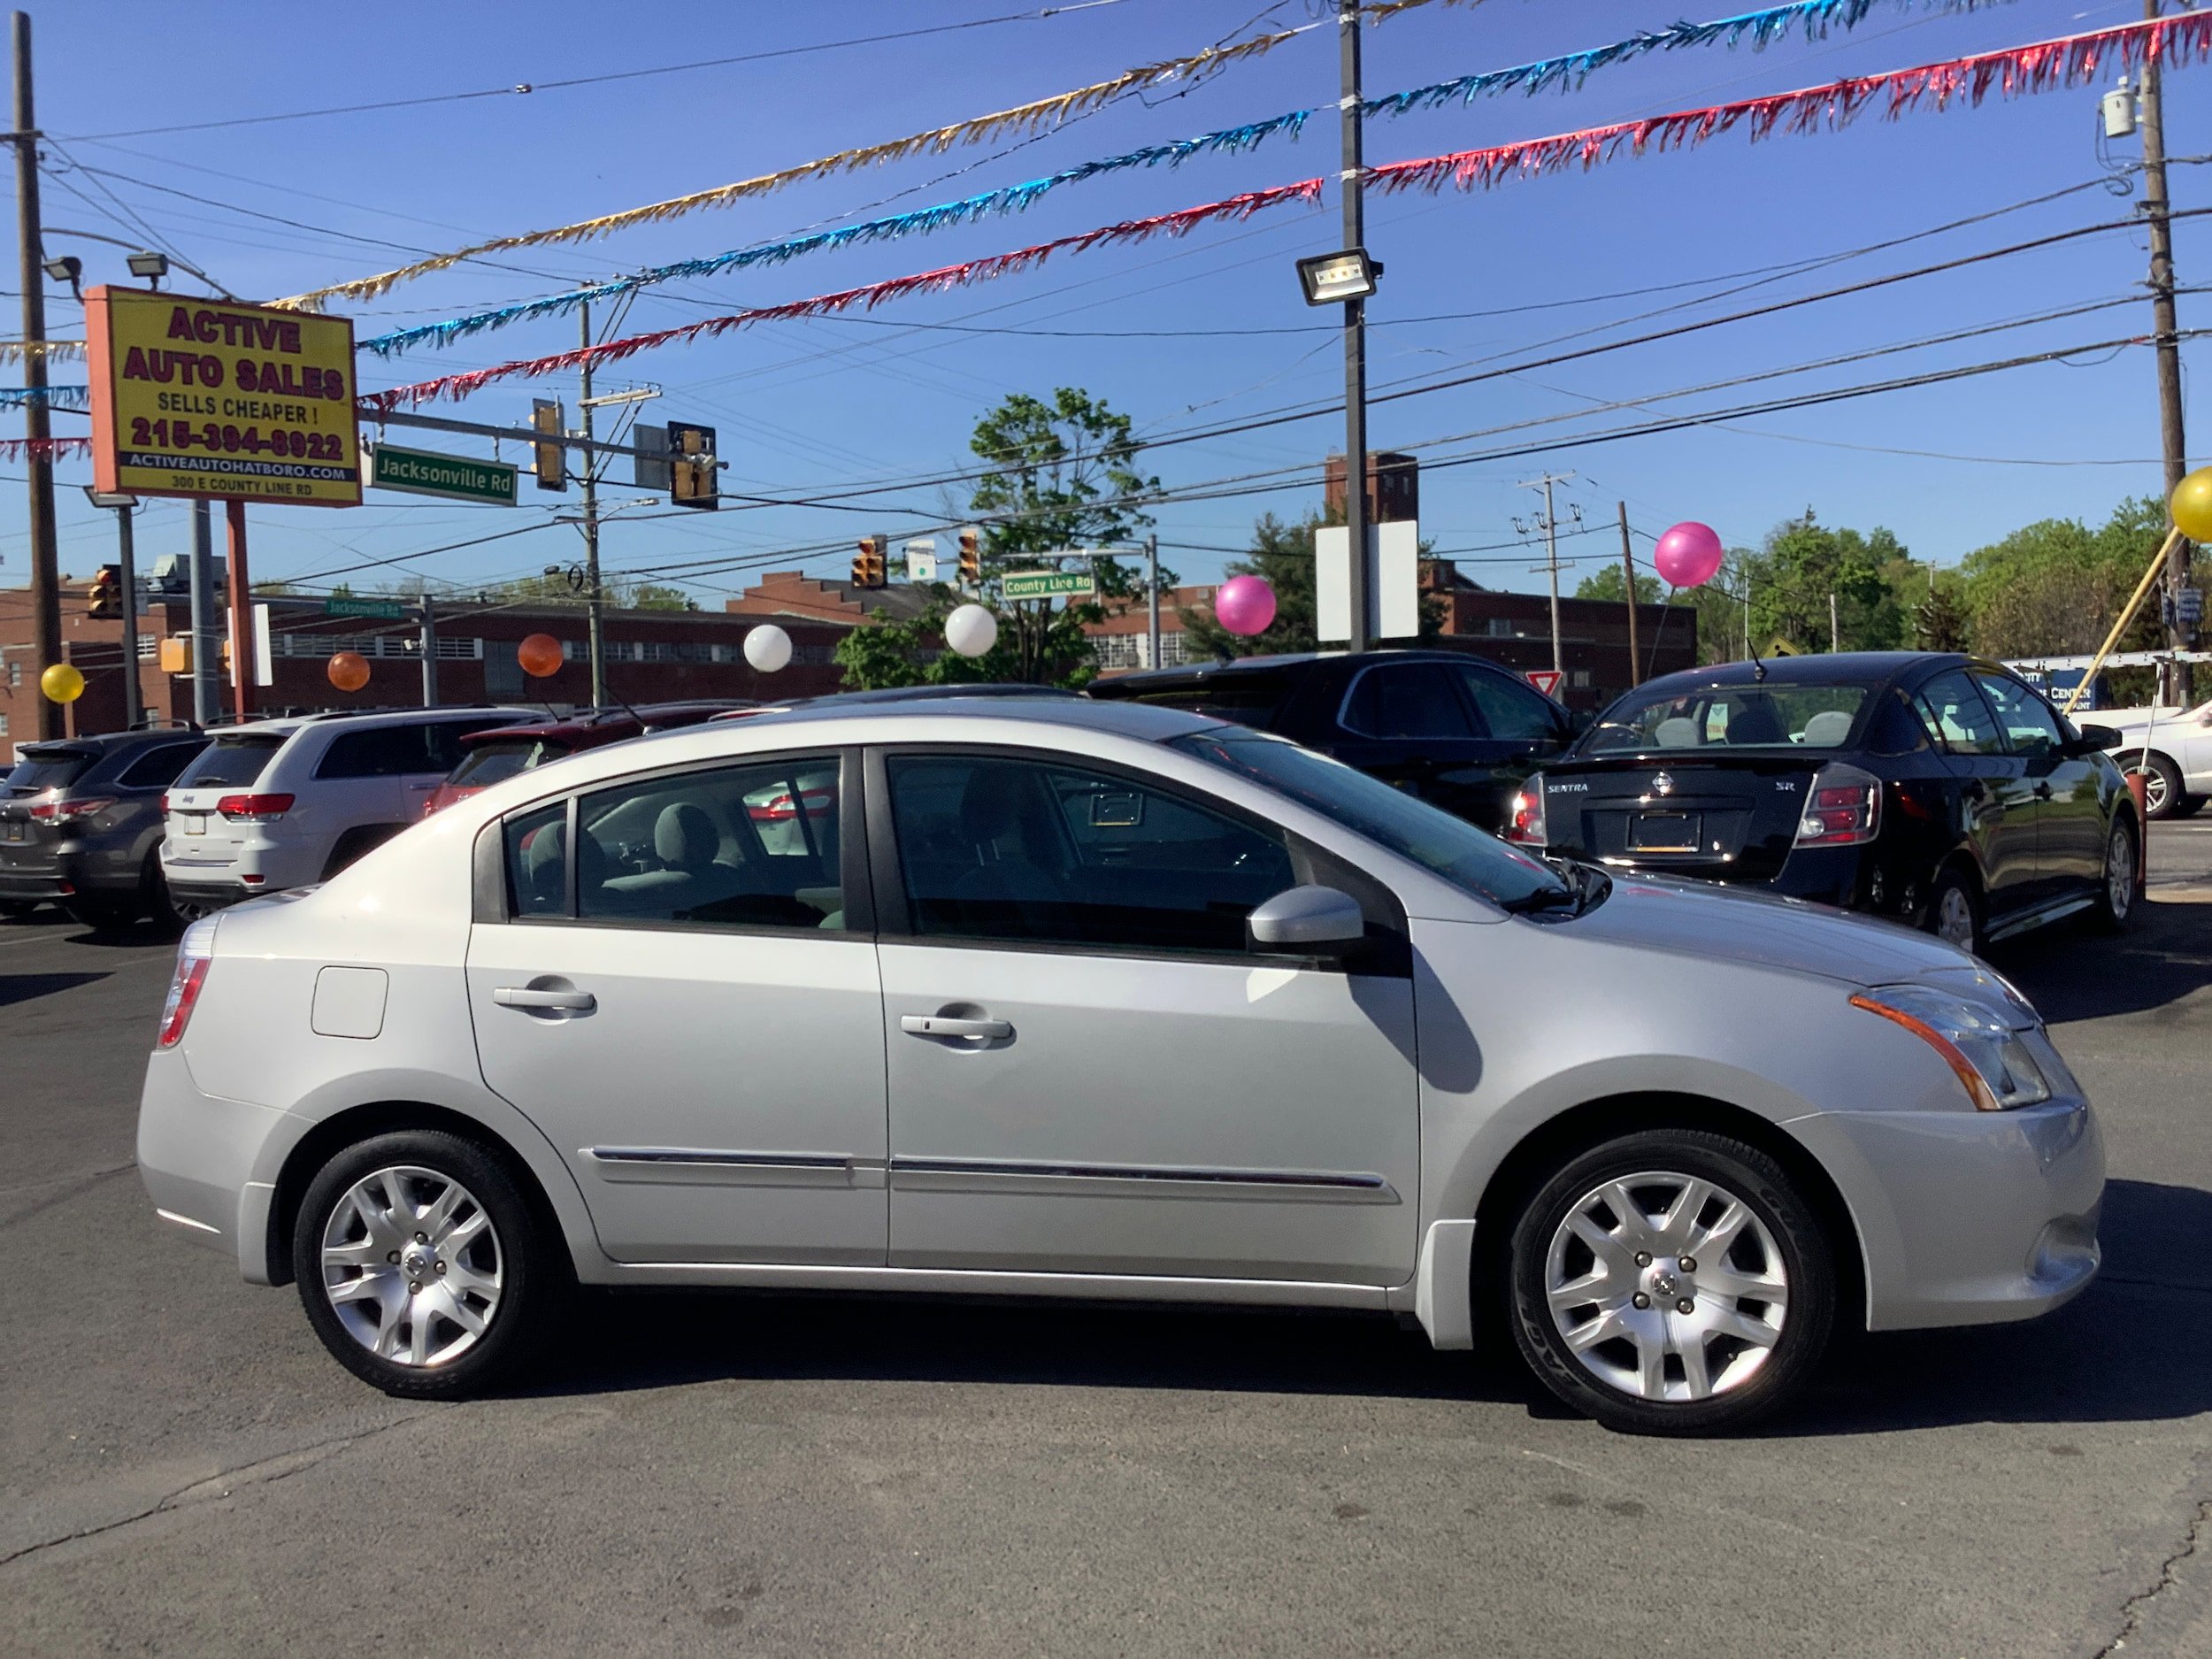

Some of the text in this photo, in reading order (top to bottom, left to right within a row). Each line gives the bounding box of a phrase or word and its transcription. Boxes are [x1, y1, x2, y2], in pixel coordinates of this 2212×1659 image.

[167, 306, 301, 353] ACTIVE
[123, 346, 344, 401] AUTO SALES
[158, 391, 216, 415] SELLS
[223, 398, 307, 425] CHEAPER
[130, 454, 345, 480] ACTIVEAUTOHATBORO.COM
[380, 457, 510, 492] Jacksonville Rd
[172, 475, 312, 495] 300 E COUNTY LINE RD
[1007, 576, 1090, 592] County Line Rd
[2051, 687, 2091, 699] CENTR
[1548, 784, 1588, 794] SENTRA
[1776, 781, 1796, 792] SR
